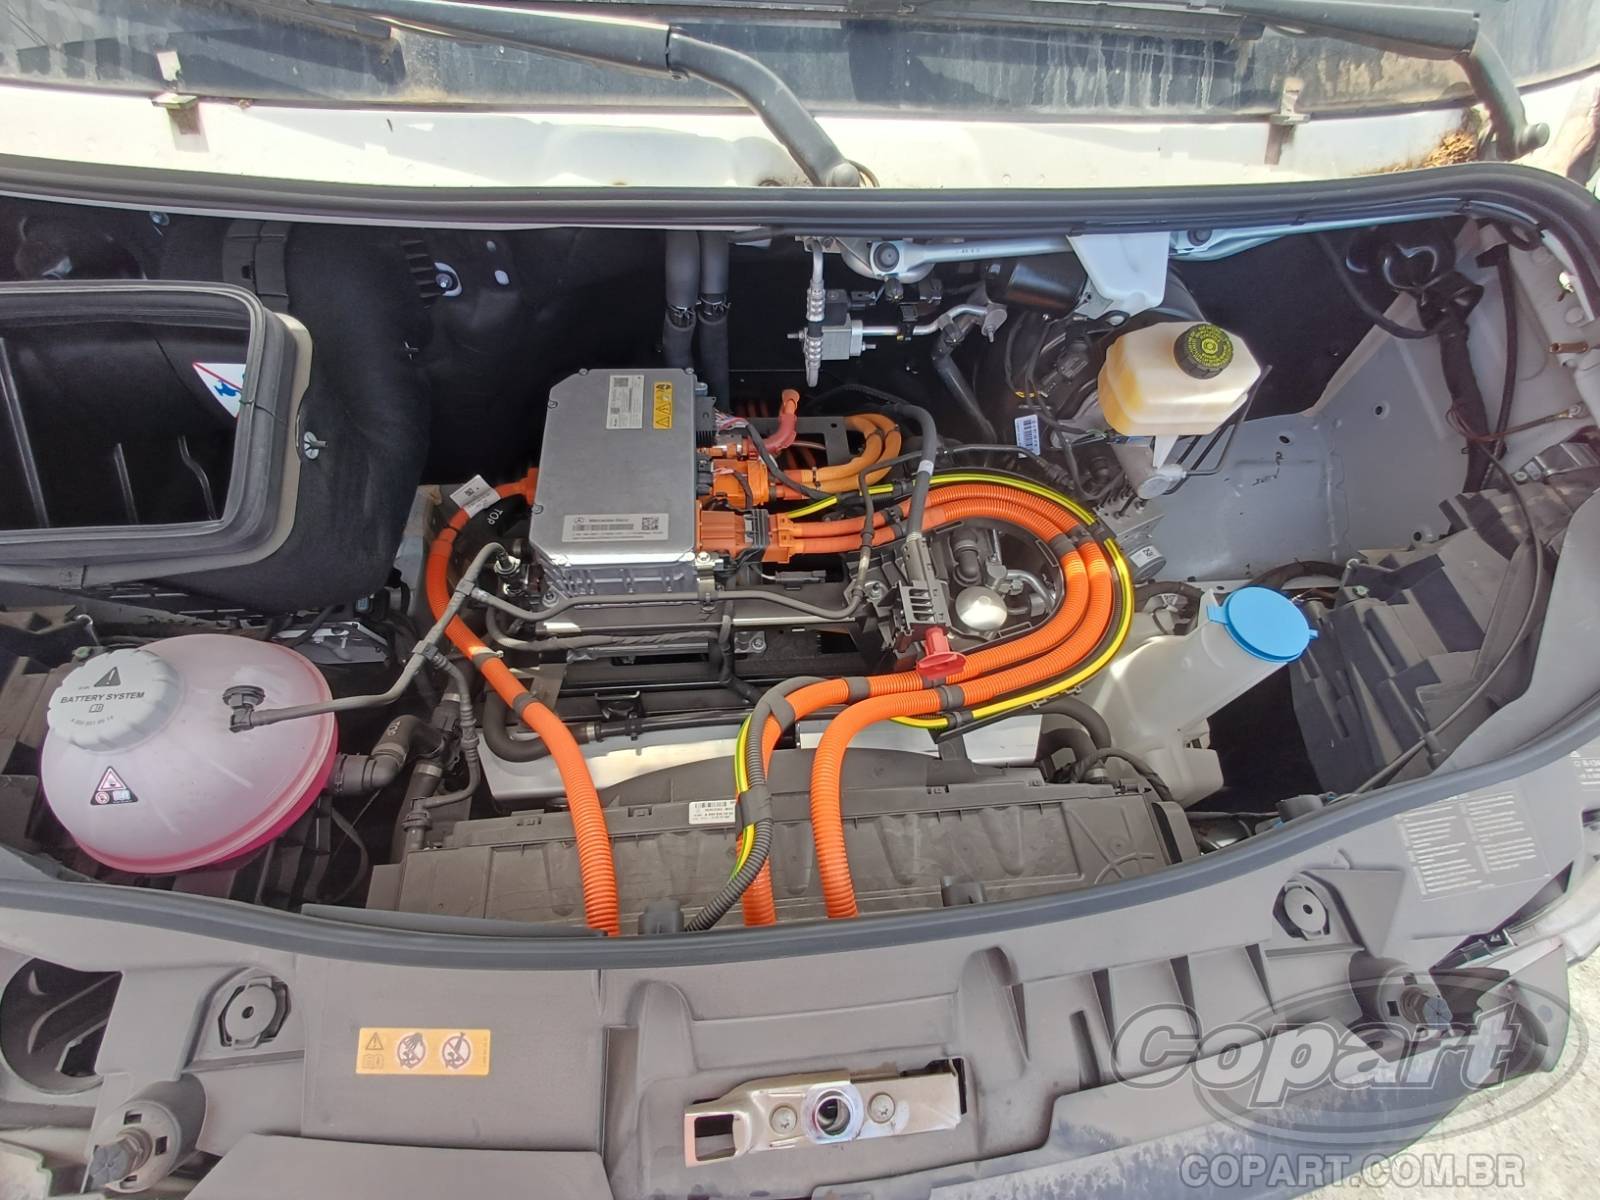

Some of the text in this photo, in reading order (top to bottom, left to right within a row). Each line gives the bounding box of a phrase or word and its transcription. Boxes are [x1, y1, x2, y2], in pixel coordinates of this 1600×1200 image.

[486, 508, 504, 526] TOP
[60, 691, 145, 704] BATTERY SYSTEM
